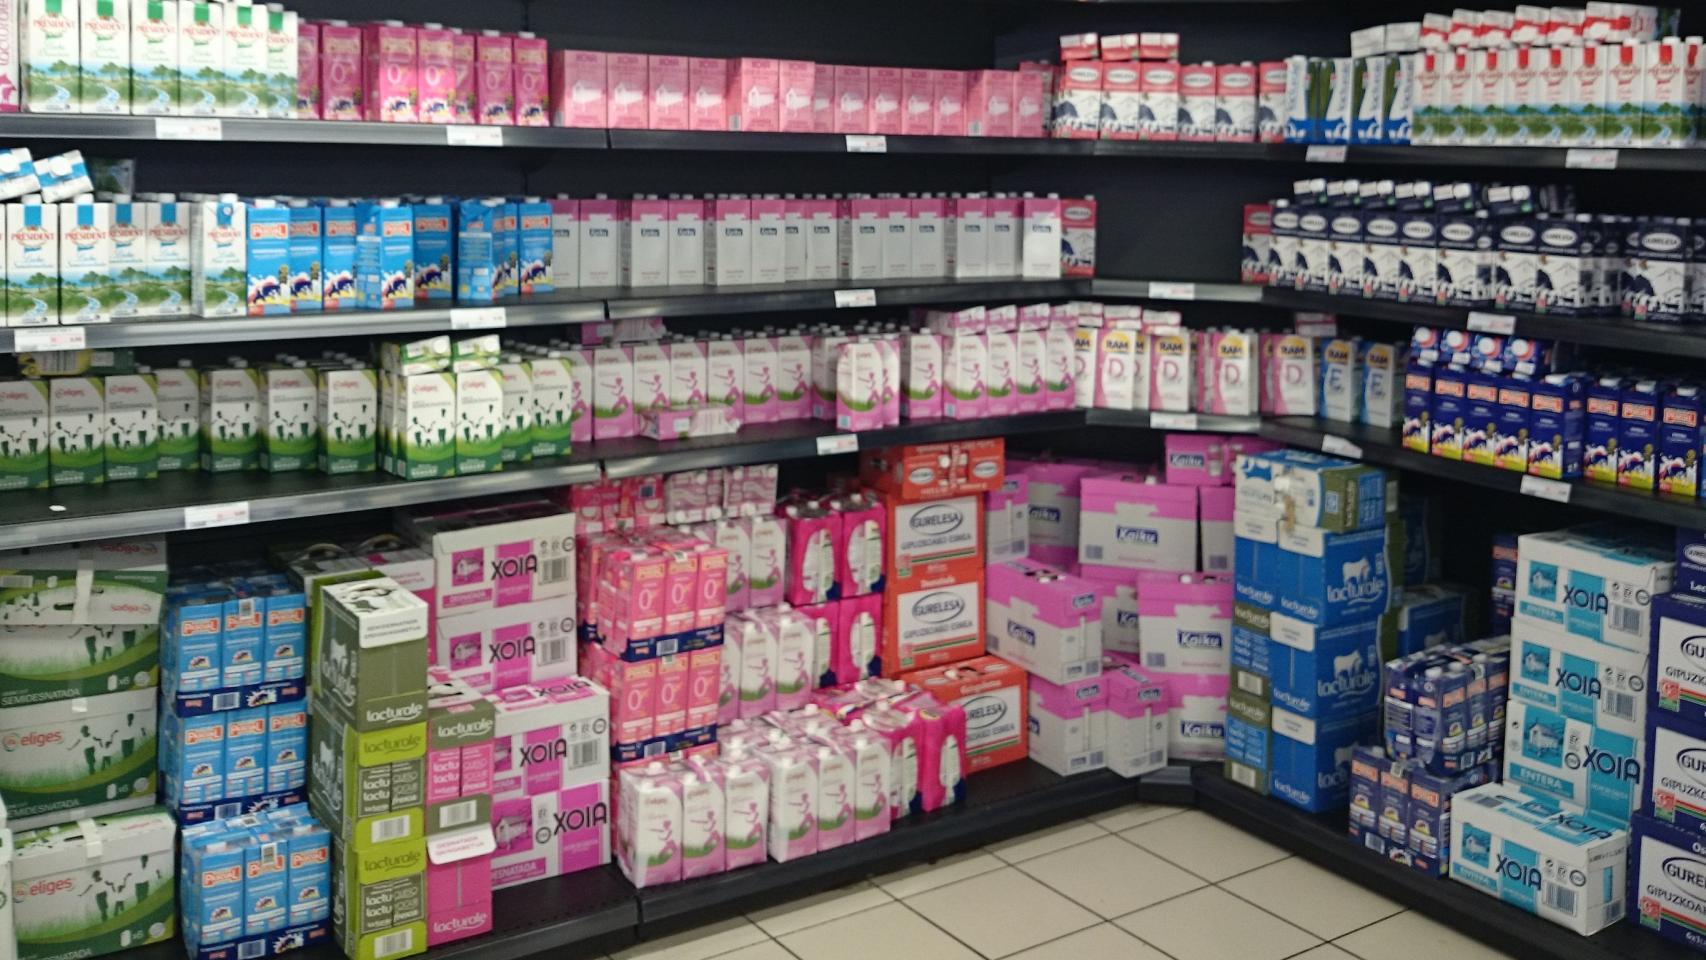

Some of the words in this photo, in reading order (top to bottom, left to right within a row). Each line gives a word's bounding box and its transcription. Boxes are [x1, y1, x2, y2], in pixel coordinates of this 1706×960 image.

[1074, 337, 1091, 348] AM
[1106, 339, 1129, 350] RAM
[1160, 341, 1183, 352] RAM
[1220, 344, 1243, 354] RAM
[1280, 344, 1305, 355] RAM
[1327, 349, 1348, 361] RAM
[1368, 352, 1388, 365] RAM
[1117, 525, 1158, 544] Kaiku
[491, 554, 538, 581] XOIA
[1327, 576, 1385, 604] lacturale
[1563, 584, 1608, 615] XOIA
[489, 635, 537, 664] XOIA
[1178, 629, 1222, 649] Kaiku
[1317, 670, 1377, 698] lacturale
[1555, 668, 1602, 700] XOIA
[366, 702, 424, 723] lacturale
[20, 730, 62, 747] eliges
[437, 717, 493, 739] lacturale
[1181, 721, 1224, 739] Kaiku
[520, 738, 567, 767] XOIA
[1583, 745, 1641, 784] XOIA
[1520, 768, 1563, 789] ENTERA
[553, 802, 607, 836] XOIA
[1494, 854, 1542, 891] XOIA
[29, 877, 73, 897] eliges
[433, 913, 487, 934] lacturale
